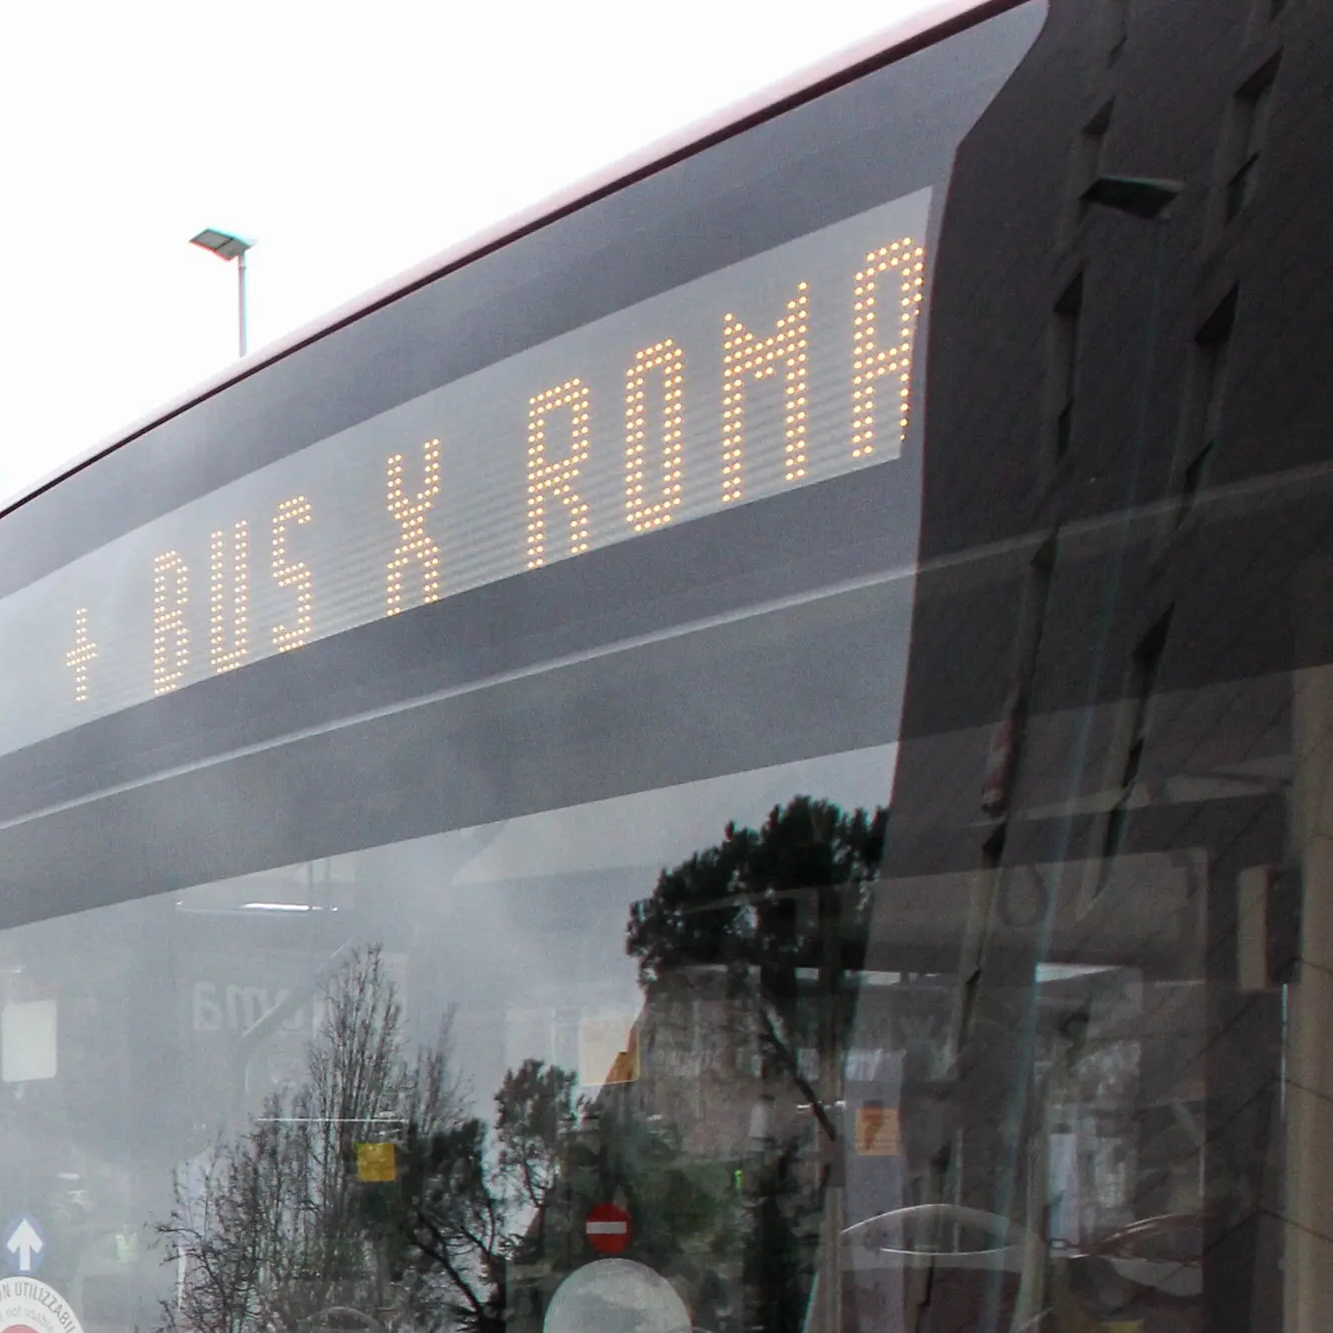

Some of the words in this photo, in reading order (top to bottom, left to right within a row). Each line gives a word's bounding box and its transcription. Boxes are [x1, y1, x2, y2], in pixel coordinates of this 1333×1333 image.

[153, 495, 313, 696] BUS
[386, 438, 442, 617] X
[527, 236, 925, 570] ROMA
